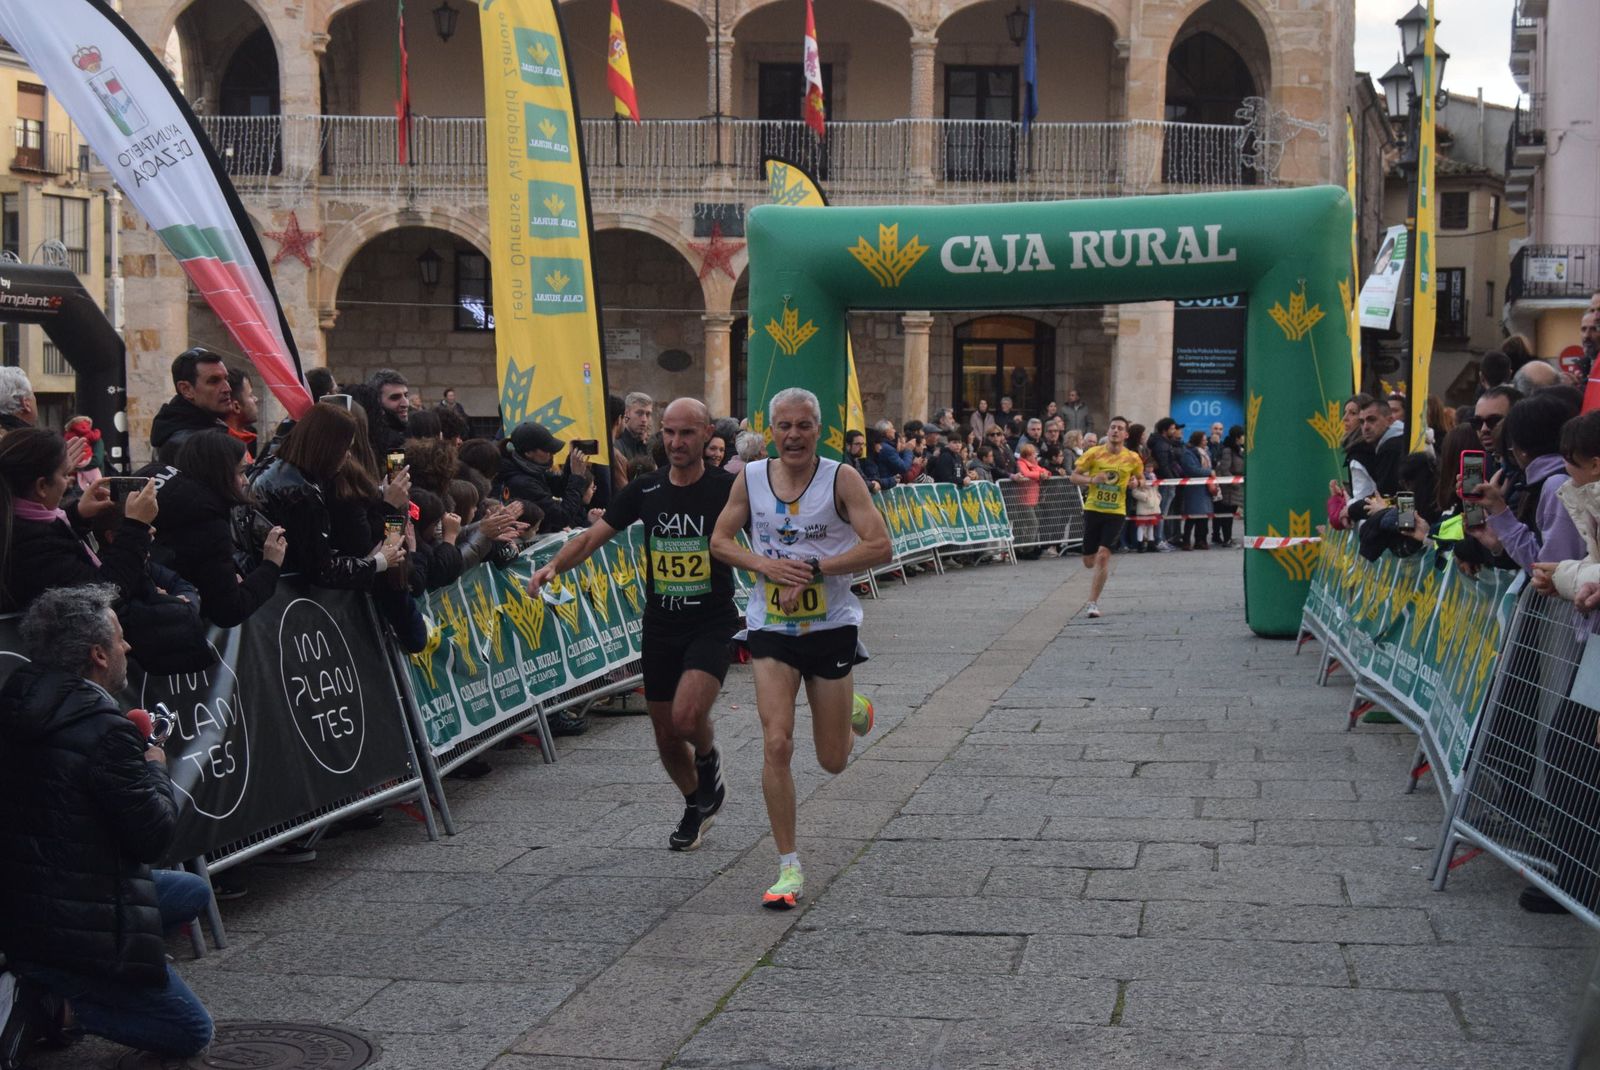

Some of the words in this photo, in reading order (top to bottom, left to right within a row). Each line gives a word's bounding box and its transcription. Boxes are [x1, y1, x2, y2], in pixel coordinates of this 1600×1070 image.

[940, 233, 1055, 274] CAJA
[1068, 224, 1237, 269] RURAL
[1189, 400, 1222, 416] 016
[1096, 490, 1118, 503] 839
[655, 512, 704, 537] SAN
[657, 555, 704, 578] 452
[771, 588, 818, 611] 40
[294, 630, 331, 663] IM
[536, 650, 562, 670] RURAL
[291, 665, 354, 707] PLAN
[538, 668, 559, 682] ZAMORA
[175, 693, 238, 740] LAN
[311, 706, 355, 742] TES
[182, 740, 236, 783] TES
